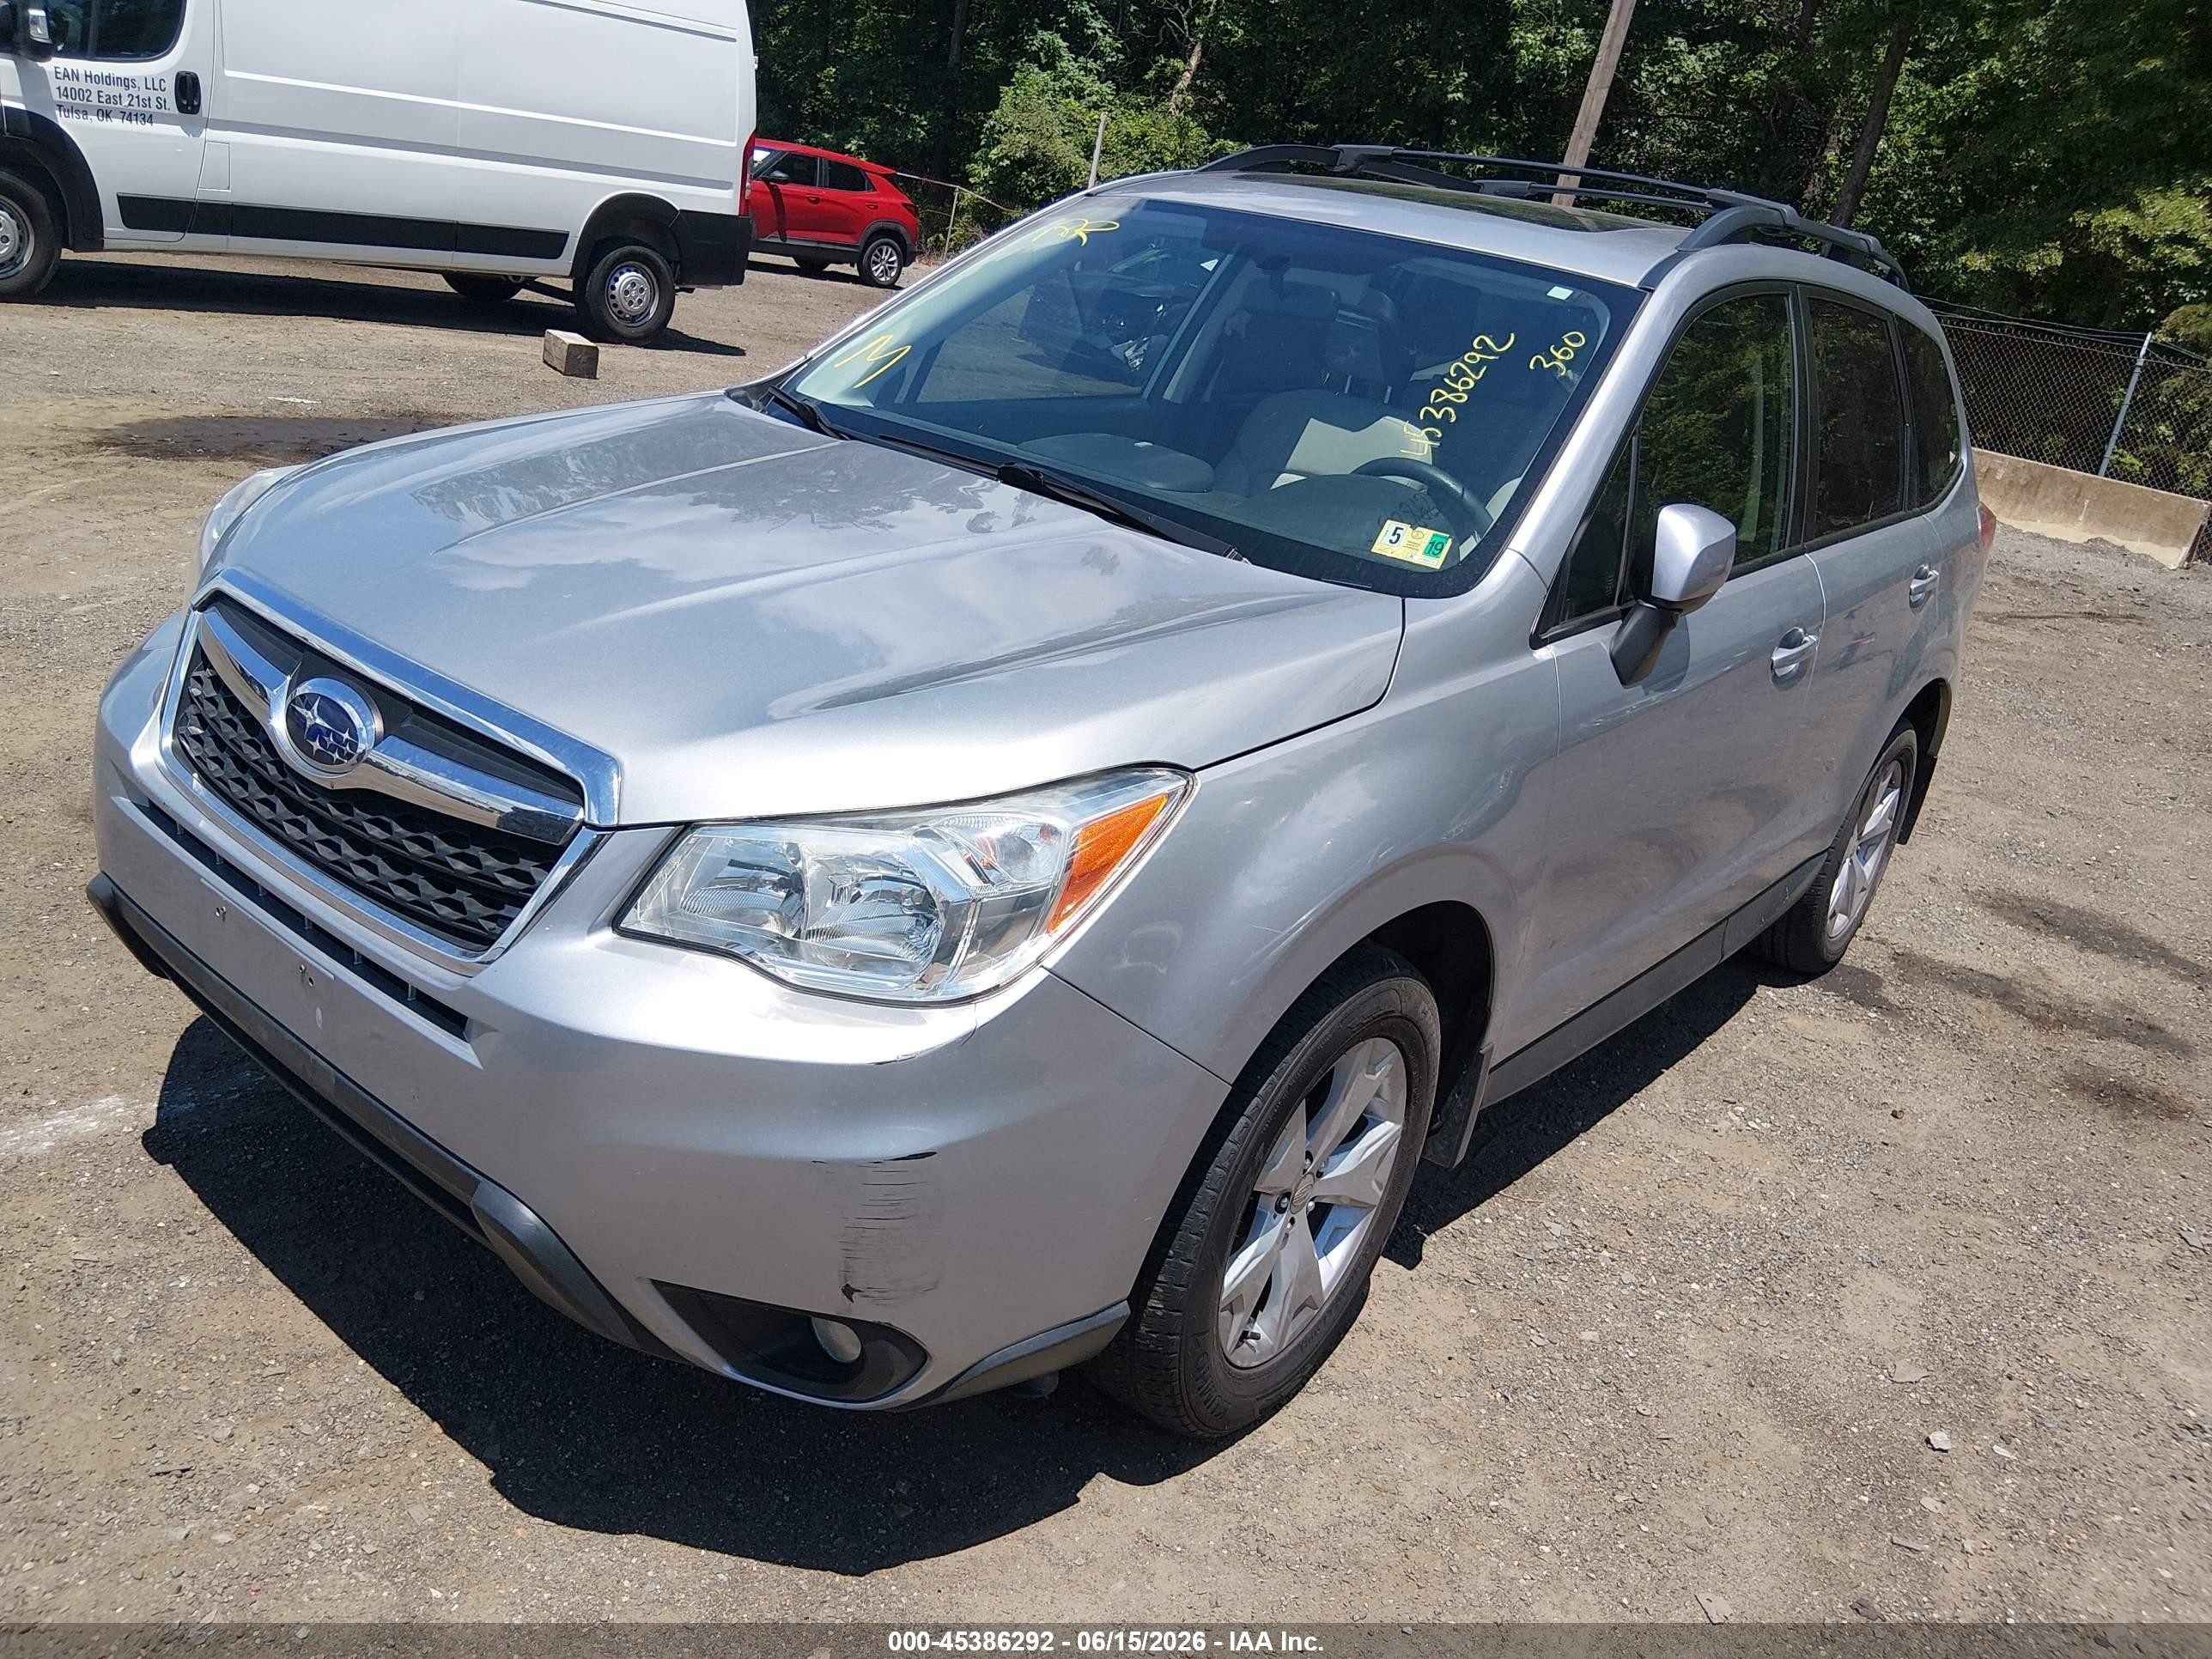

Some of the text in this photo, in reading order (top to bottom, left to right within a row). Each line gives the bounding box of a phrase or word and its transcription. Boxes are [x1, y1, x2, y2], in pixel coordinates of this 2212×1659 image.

[54, 66, 167, 92] EAN Holdings, LLC
[56, 86, 170, 111] 14002 East 21st St.
[56, 105, 154, 126] Tulsa, OK 74134
[1529, 331, 1587, 376] 360
[1400, 332, 1515, 456] 45386292
[1389, 526, 1404, 544] 5
[1426, 540, 1444, 556] 19
